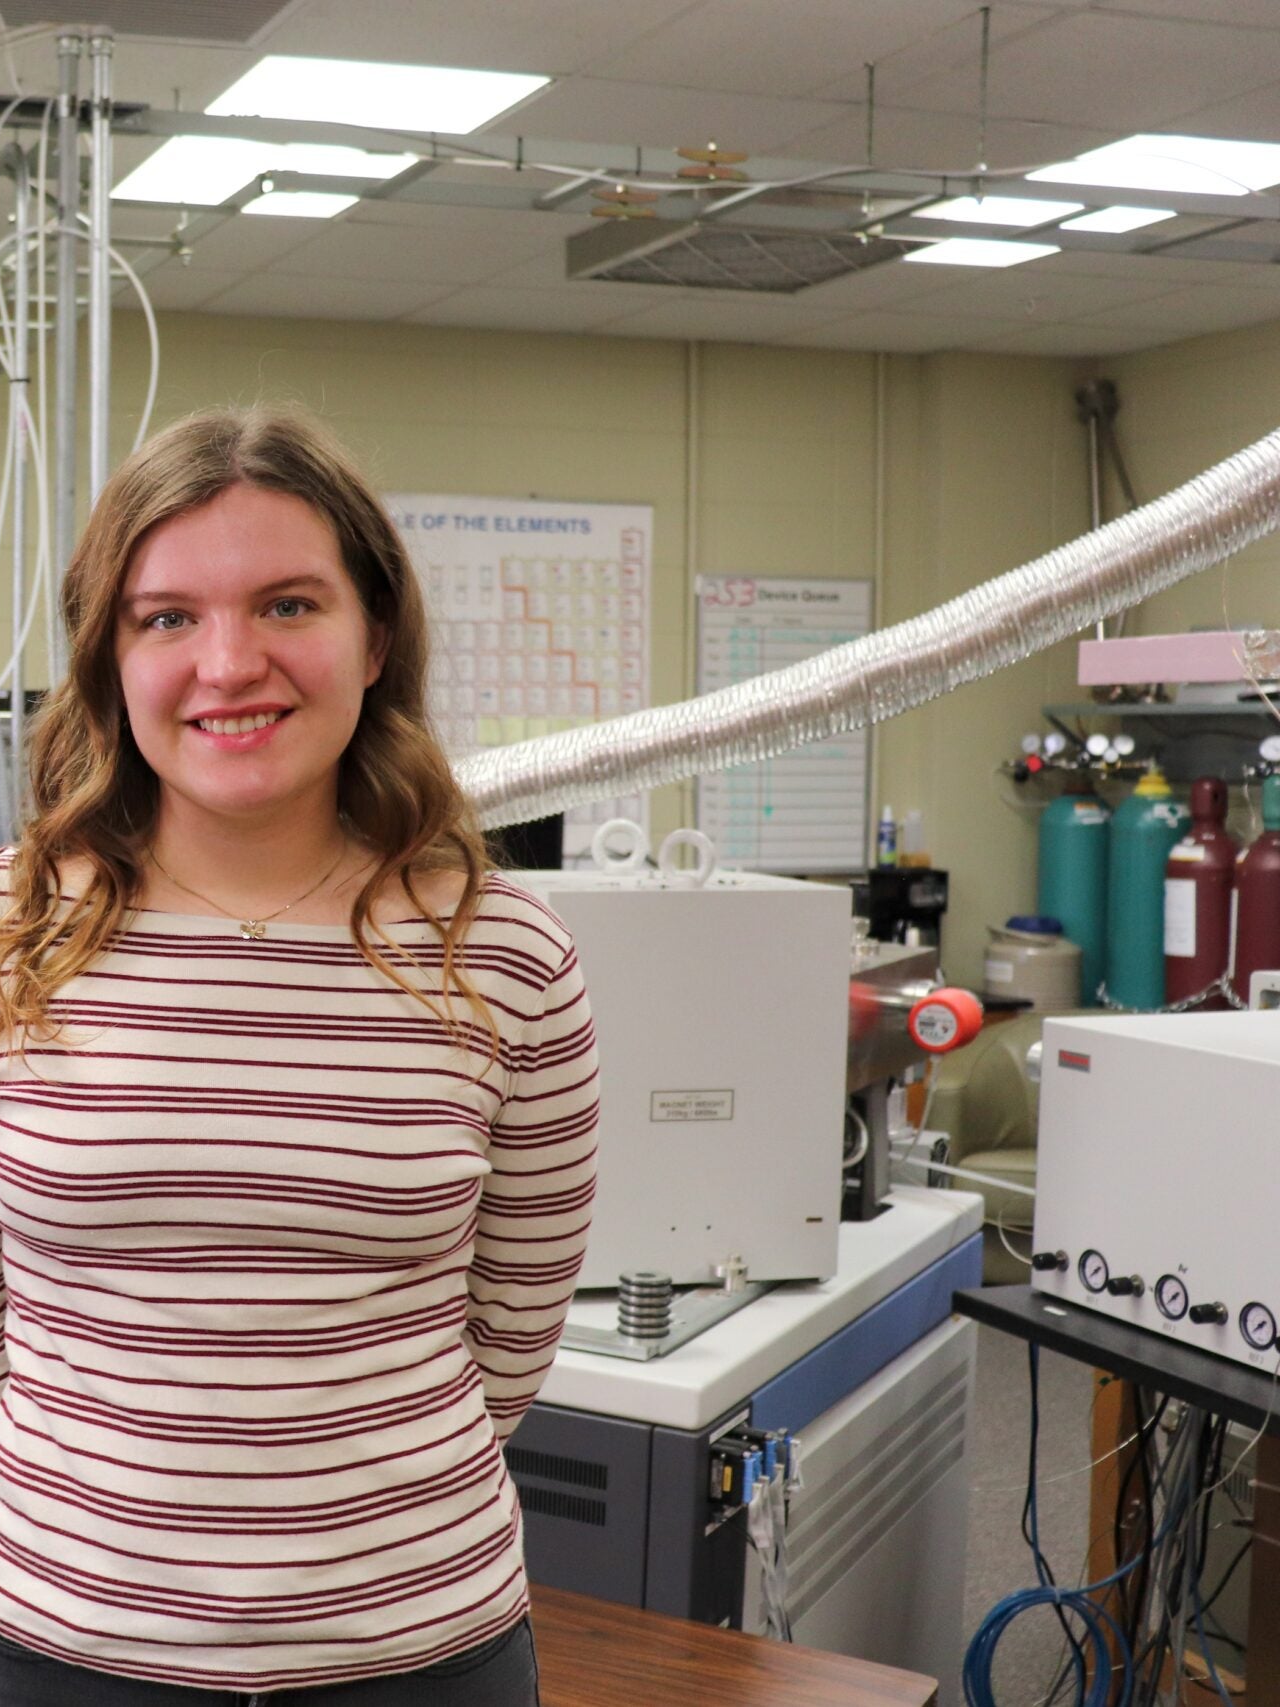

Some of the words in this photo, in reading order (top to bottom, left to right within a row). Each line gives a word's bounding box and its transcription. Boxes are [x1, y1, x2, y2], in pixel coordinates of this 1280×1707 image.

[421, 514, 447, 530] OF
[454, 515, 487, 531] THE
[494, 516, 591, 534] ELEMENTS
